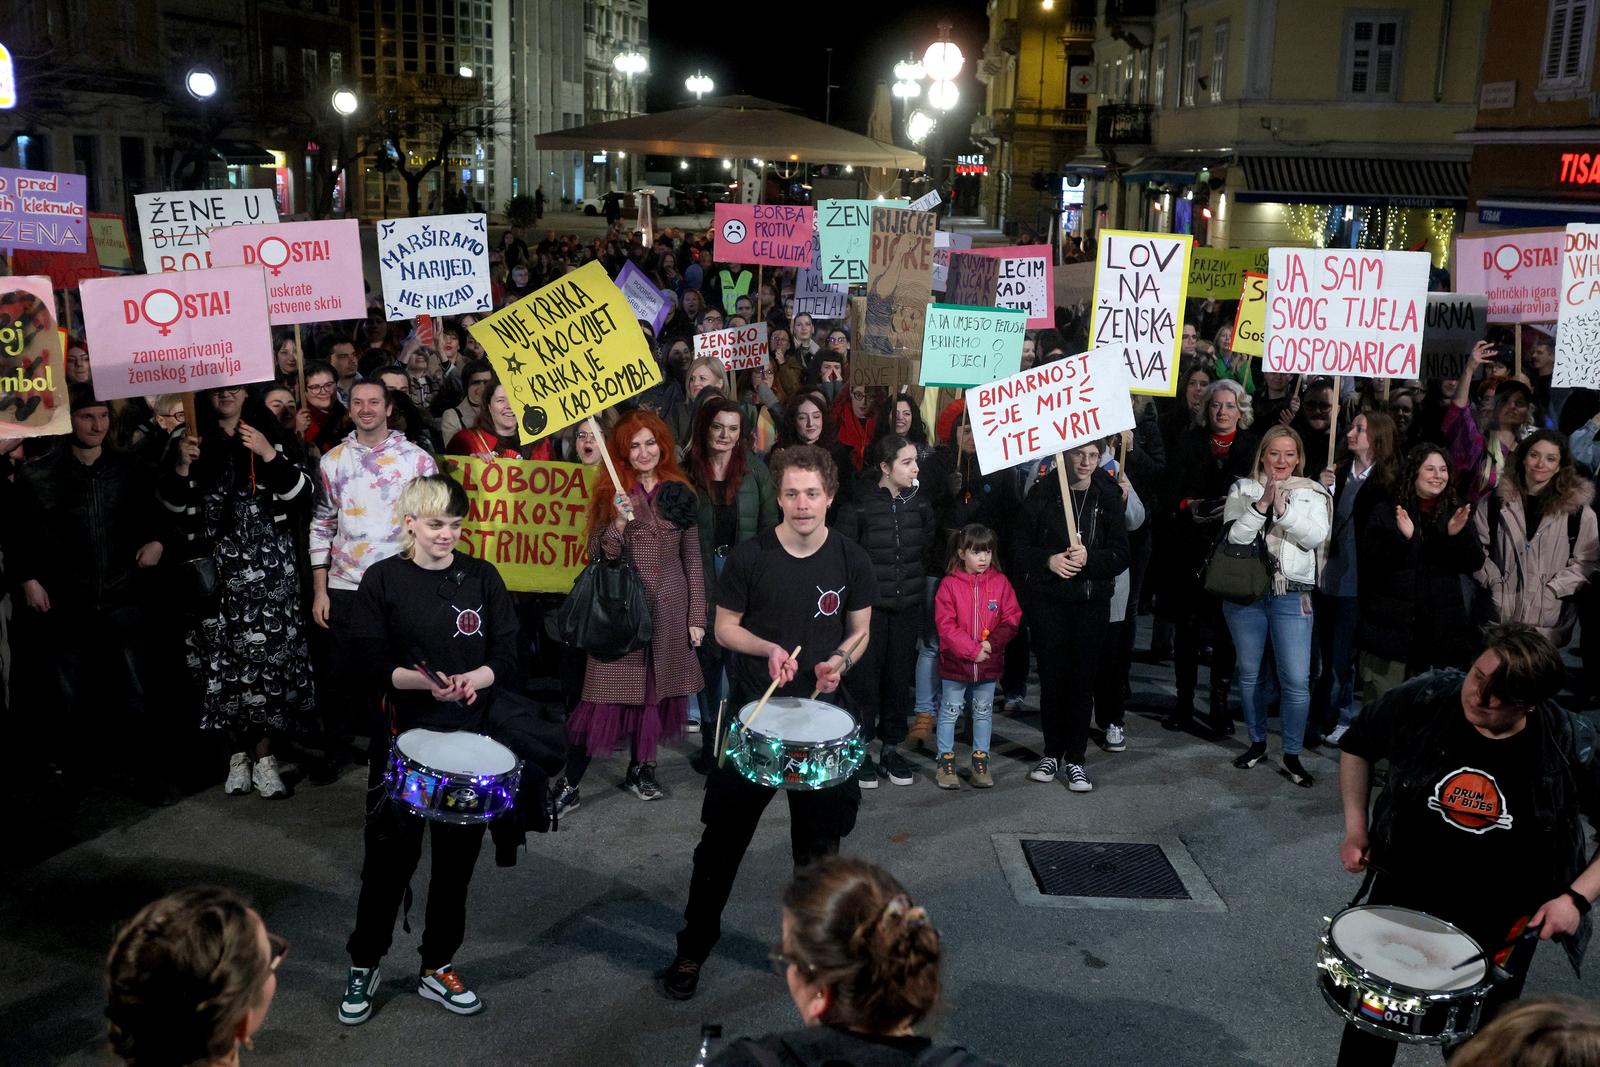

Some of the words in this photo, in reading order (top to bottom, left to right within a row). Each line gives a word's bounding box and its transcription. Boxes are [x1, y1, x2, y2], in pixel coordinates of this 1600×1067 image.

[17, 175, 57, 197] pred
[23, 198, 83, 216] kleknula
[148, 197, 226, 223] ŽENE
[244, 195, 260, 220] U
[753, 205, 806, 224] BORBA
[755, 222, 795, 238] PROTIV
[381, 225, 484, 270] MARŠIRAMO
[752, 240, 812, 263] CELULITA?
[1107, 237, 1180, 272] LOV
[1194, 258, 1230, 272] PRIZIV
[1276, 254, 1308, 293] JA
[1322, 256, 1383, 291] SAM
[270, 283, 312, 298] uskrate
[1119, 272, 1160, 303] NA
[1190, 272, 1237, 292] SAVJESTI
[314, 296, 342, 311] skrbi
[398, 289, 421, 309] NE
[426, 284, 474, 310] NAZAD
[1531, 288, 1556, 302] igara
[490, 310, 535, 350] NIJE
[526, 280, 595, 328] KRHKA
[1272, 296, 1329, 330] SVOG
[1342, 297, 1418, 333] TIJELA
[1512, 301, 1551, 316] zdravlja
[1096, 299, 1176, 344] ŽENSKA
[700, 328, 758, 350] ŽENSKO
[928, 334, 980, 350] BRINEMO
[132, 340, 233, 364] zanemarivanja
[724, 356, 762, 371] STVAR
[1268, 334, 1416, 375] GOSPODARICA
[128, 361, 188, 384] ženskog
[190, 357, 242, 379] zdravlja
[527, 360, 588, 402] KRHKA
[583, 348, 606, 380] JE
[979, 355, 1090, 408] BINARNOST
[558, 389, 591, 421] KAO
[591, 358, 655, 404] BOMBA
[1000, 406, 1023, 425] JE
[1036, 387, 1073, 415] MIT
[1053, 407, 1102, 442] VRIT
[447, 459, 588, 498] LOBODA
[1454, 786, 1485, 800] DRUM
[1461, 798, 1493, 812] BIJES
[1384, 1010, 1409, 1026] 041
